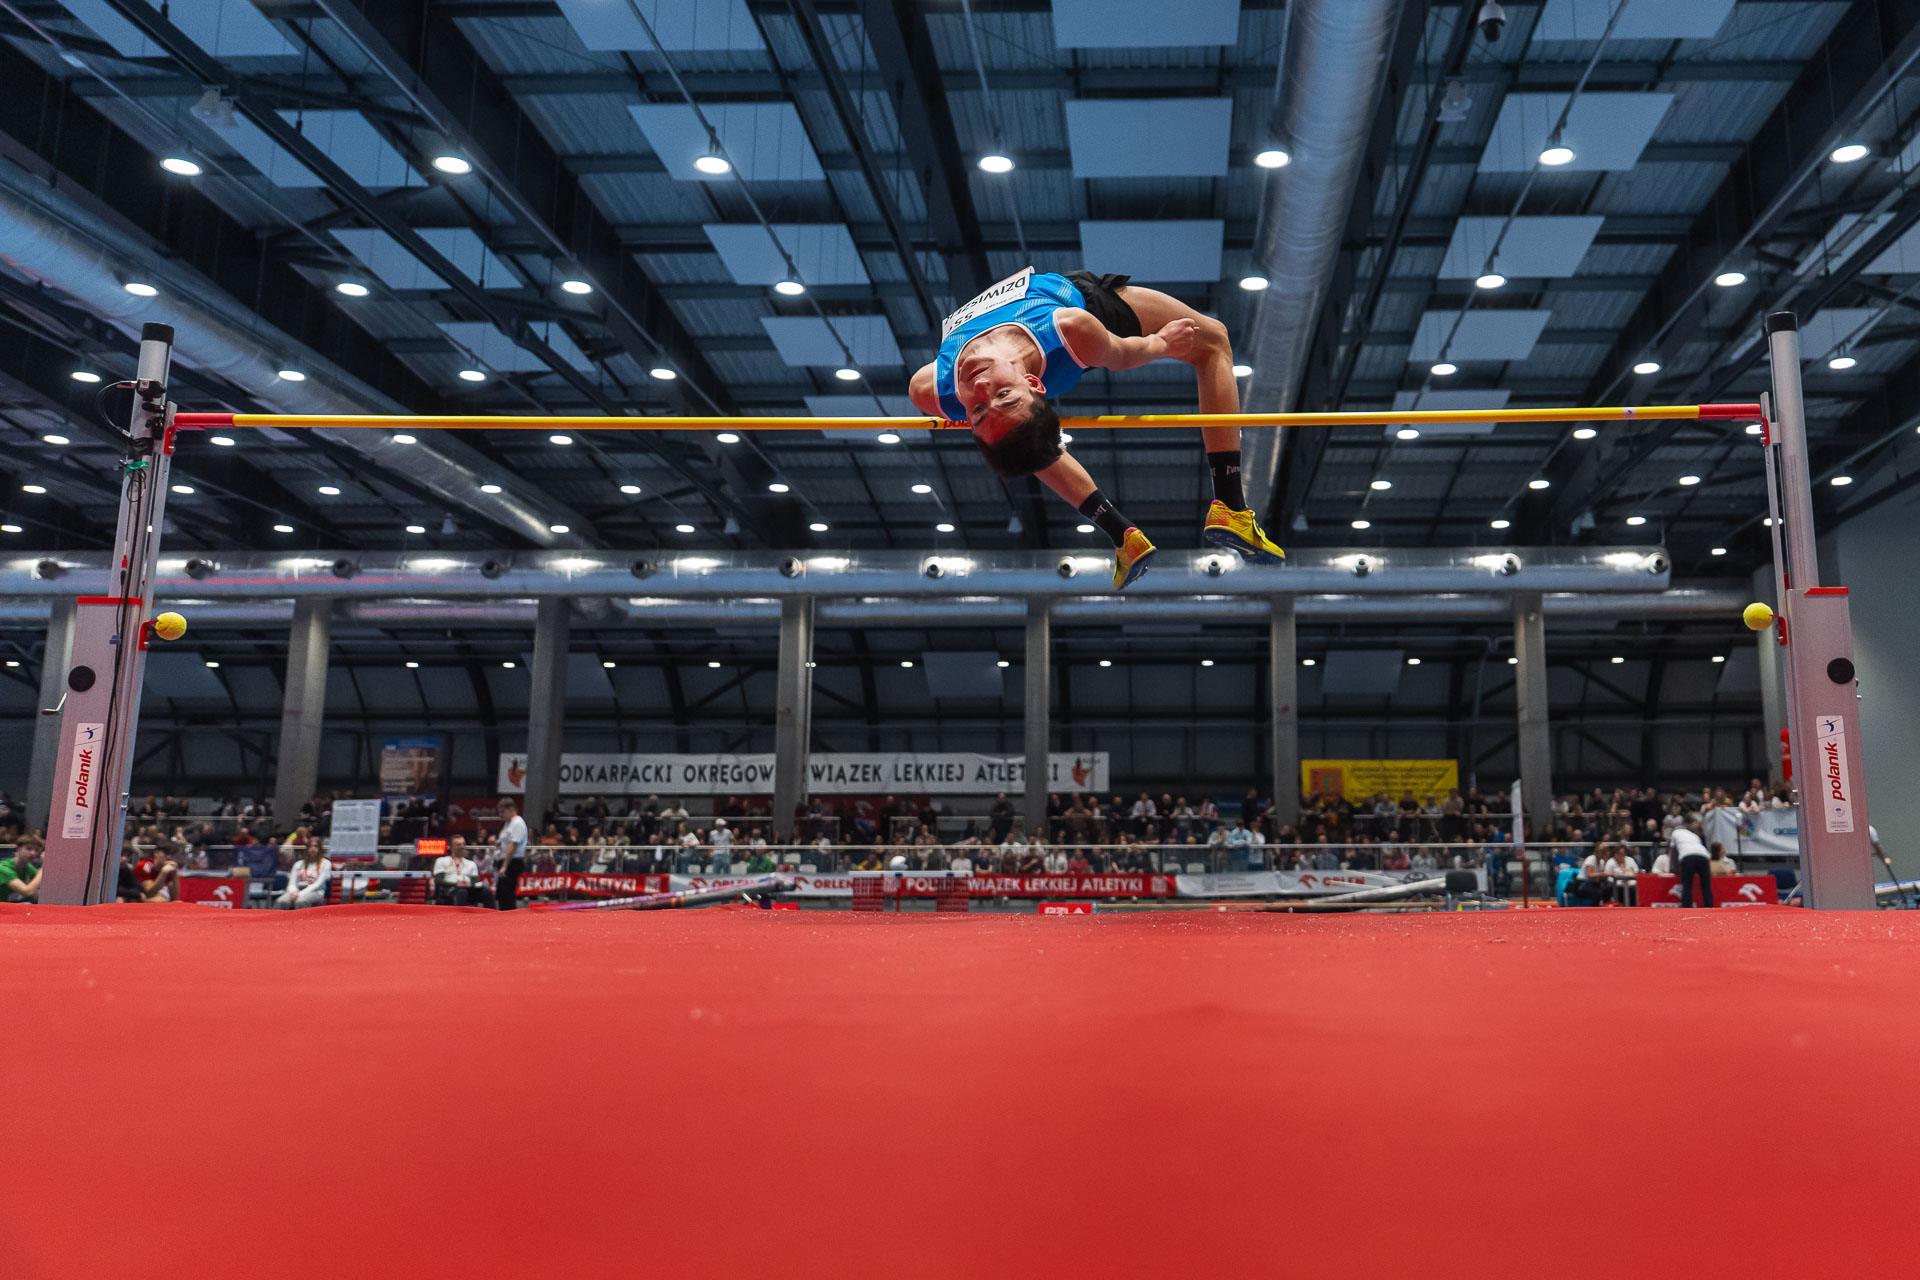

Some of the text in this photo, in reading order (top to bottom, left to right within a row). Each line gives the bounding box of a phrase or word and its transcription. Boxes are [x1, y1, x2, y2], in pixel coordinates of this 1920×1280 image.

[75, 748, 92, 808] polanik
[559, 763, 1059, 785] ODKARPACKI OKRĘGOW WIĄZEK LEKKIEJ ATLETI
[1824, 741, 1846, 802] polanik
[519, 876, 571, 892] LEKKIEJ
[575, 877, 637, 892] ATLETYKI
[968, 878, 1021, 894] WIĄZEK
[1024, 877, 1077, 891] LEKKIEJ
[1081, 877, 1143, 891] ATLETYKI
